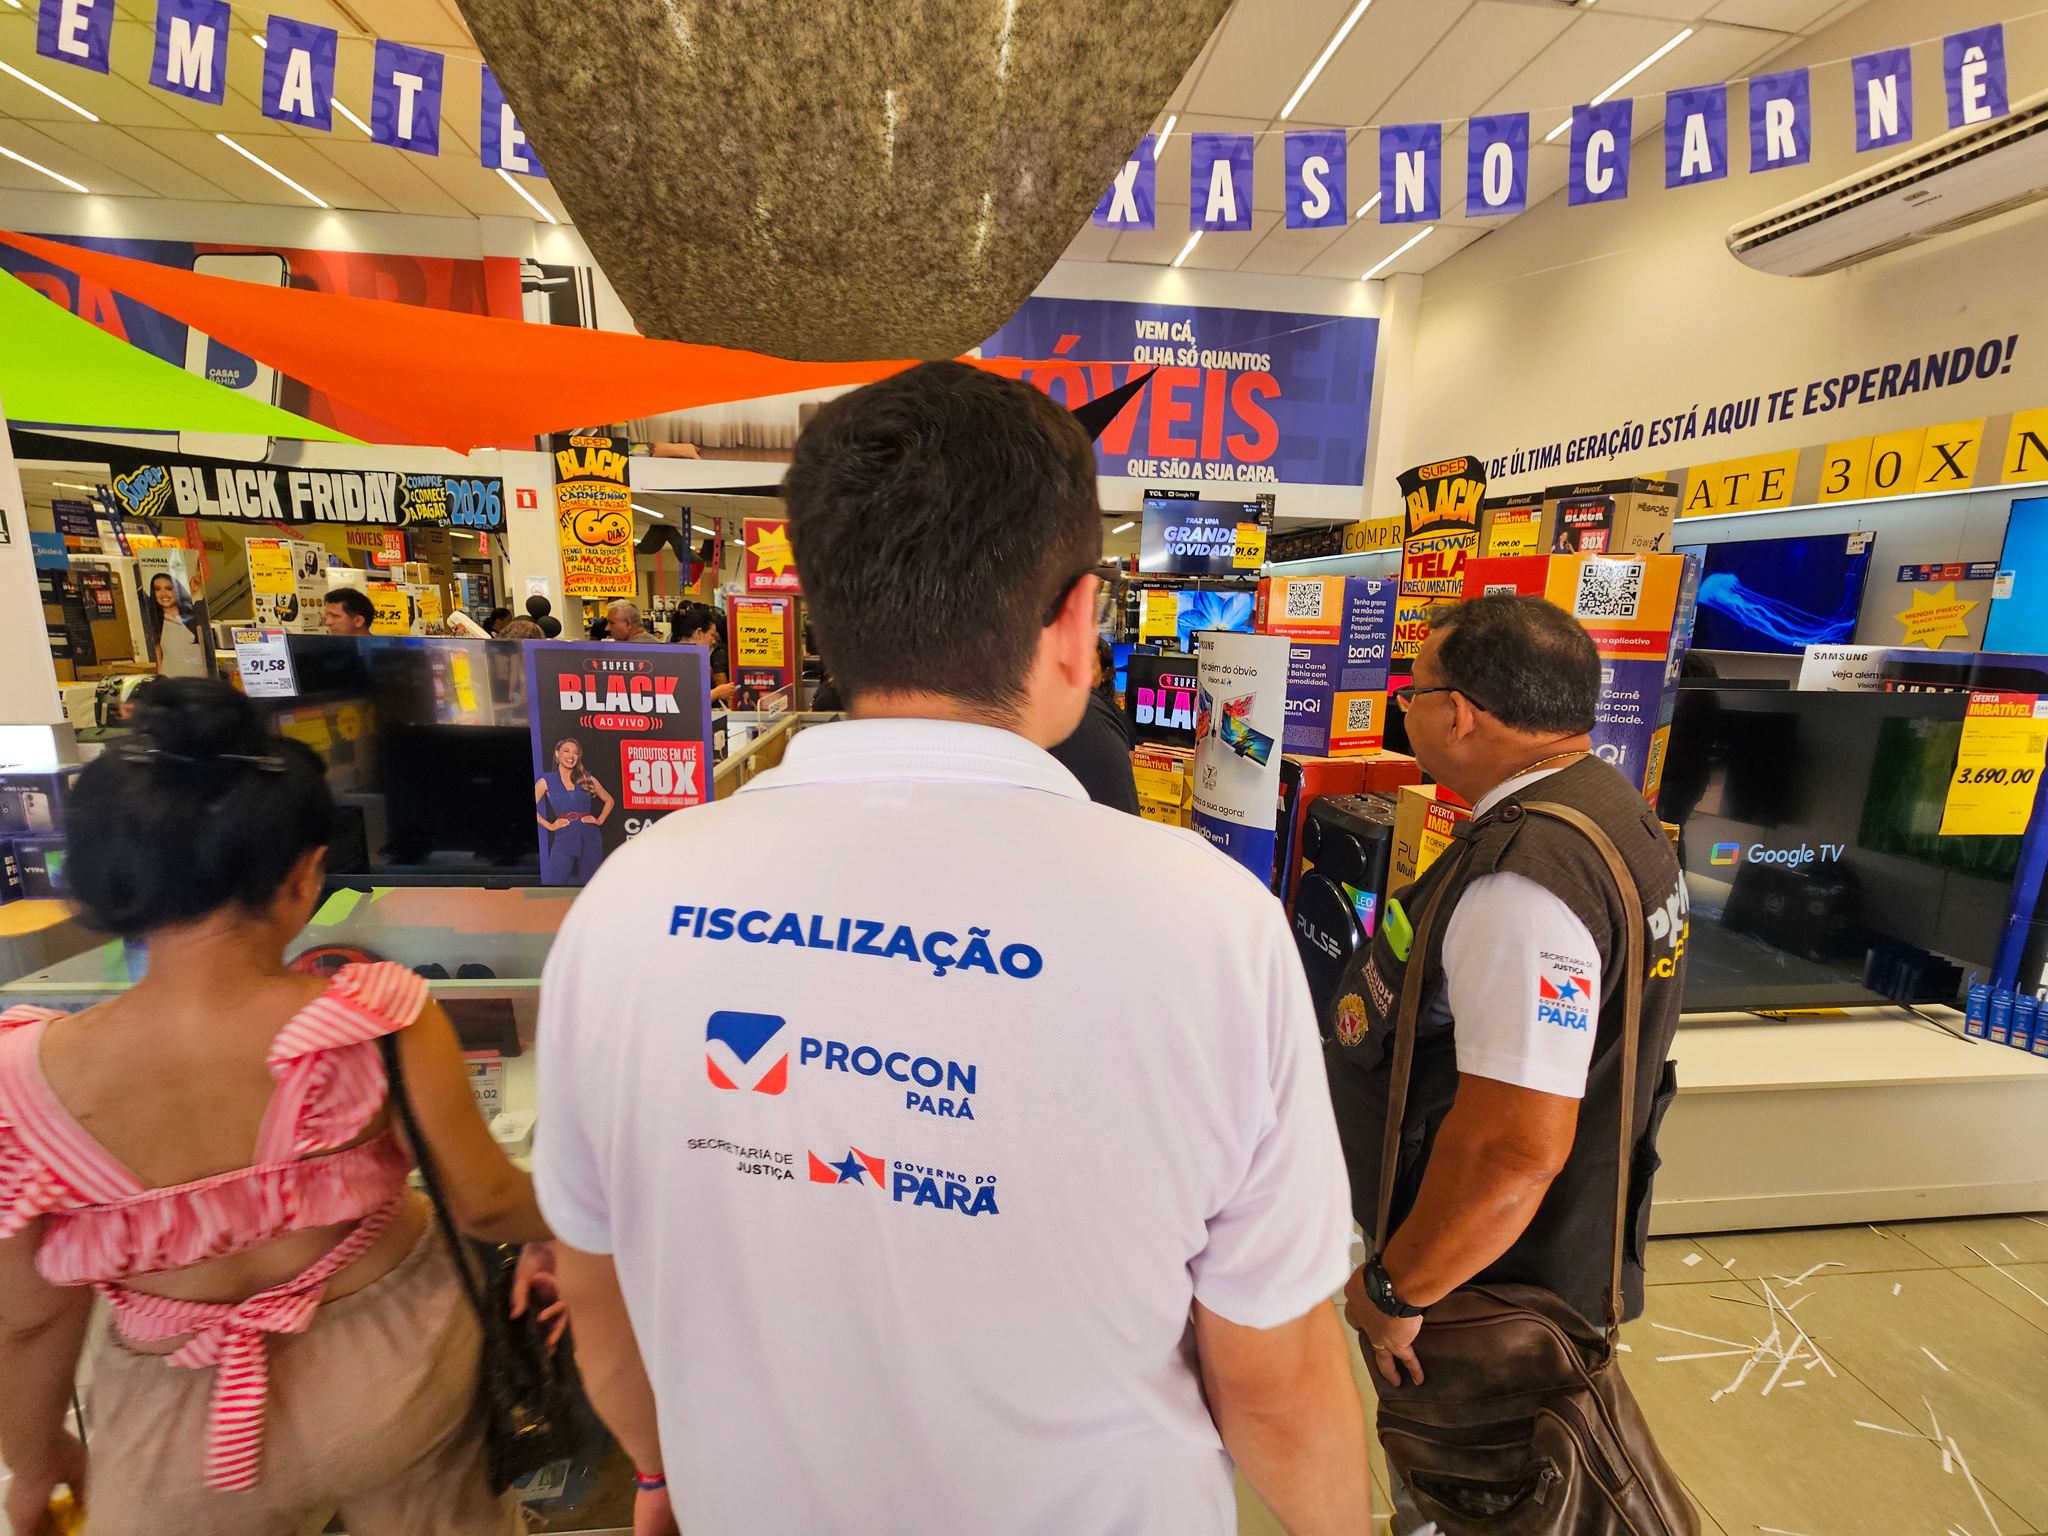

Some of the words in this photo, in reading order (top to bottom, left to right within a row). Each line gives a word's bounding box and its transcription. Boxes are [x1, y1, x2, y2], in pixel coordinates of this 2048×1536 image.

[1135, 320, 1168, 340] VEM
[1171, 319, 1196, 345] CÁ,
[1134, 345, 1174, 366] OLHA
[1178, 345, 1198, 367] SÓ
[1201, 350, 1270, 372] QUANTOS
[209, 368, 239, 378] CASAS
[1000, 334, 1281, 462] ÓVEIS
[1490, 456, 1508, 480] DE
[1510, 445, 1562, 475] ÚLTIMA
[1566, 420, 1644, 464] GERAÇÃO
[1648, 404, 1699, 447] ESTÁ
[1702, 396, 1760, 437] AQUI
[1768, 387, 1798, 423] TE
[1802, 334, 2018, 416] ESPERANDO!
[572, 437, 608, 447] SUPER
[556, 447, 628, 483] BLACK
[1127, 459, 1158, 477] QUE
[1160, 458, 1190, 478] SÃO
[1192, 462, 1202, 479] A
[1205, 463, 1234, 481] SUA
[1237, 465, 1278, 483] CARA.
[1422, 459, 1466, 479] SUPER
[406, 476, 443, 488] COMPRE
[1687, 468, 1785, 510] ATE
[1827, 440, 1972, 495] 30X
[118, 466, 163, 510] Super
[170, 466, 283, 518] BLACK
[288, 472, 397, 523] FRIDAY
[415, 488, 446, 503] COMECE
[560, 485, 606, 493] COMPRE
[1572, 484, 1602, 494] Amvox
[445, 479, 500, 525] 2026
[560, 492, 627, 502] CARNEZINHO
[562, 500, 590, 508] COMECE
[600, 500, 628, 508] PAGAR
[416, 502, 447, 520] PAGAR
[1407, 478, 1486, 533] BLACK
[1494, 515, 1529, 524] IMBATÍVEL
[1565, 507, 1605, 522] BLACK
[438, 518, 451, 527] EM
[573, 509, 631, 546] 60
[346, 528, 383, 547] MÓVEIS
[607, 527, 626, 540] DIAS
[1164, 526, 1237, 543] GRANDE
[1408, 535, 1466, 555] SHOW
[1465, 534, 1477, 548] DE
[1581, 537, 1605, 549] 30X
[37, 547, 62, 555] Midea
[1236, 548, 1259, 557] 91,62
[567, 565, 592, 574] LINHA
[594, 564, 629, 574] BRANCA
[1408, 550, 1467, 579] TELA
[755, 576, 772, 585] SEM
[1351, 615, 1383, 623] Empréstimo
[1400, 606, 1427, 622] NÃO
[1905, 610, 1934, 620] MENOR
[1936, 604, 1965, 615] PREÇO
[1912, 617, 1933, 625] BLACK
[1934, 613, 1958, 622] FRIDAY
[1393, 641, 1419, 654] ANTES
[1609, 637, 1651, 646] aplicativo
[1348, 645, 1384, 659] banQi
[1814, 652, 1868, 661] SAMSUNG
[251, 660, 285, 672] 91,58
[602, 661, 635, 671] SUPER
[1222, 665, 1231, 674] do
[1233, 665, 1257, 676] óbvio
[744, 675, 775, 685] BLACK
[1208, 676, 1219, 684] Vision
[1832, 670, 1852, 680] Veja
[1855, 670, 1879, 679] além
[559, 674, 680, 714] BLACK
[1603, 690, 1640, 700] Carnê
[1972, 695, 1999, 703] OFERTA
[1284, 699, 1321, 713] anQi
[1614, 704, 1640, 712] com
[1969, 702, 2031, 716] IMBATÍVEL
[599, 717, 614, 727] AO
[618, 718, 644, 728] VIVO
[628, 746, 668, 760] PRODUTOS
[669, 748, 680, 760] EM
[682, 745, 696, 761] ATÉ
[1135, 753, 1150, 761] OFERTA
[1134, 759, 1170, 771] IMBATÍVEL
[629, 760, 698, 795] 30X
[1957, 768, 2035, 786] 3.690,00
[1219, 807, 1244, 818] agora!
[1430, 805, 1454, 821] OFERTA
[1212, 835, 1223, 844] em
[1426, 836, 1446, 850] TORRE
[1748, 843, 1815, 868] Google
[1820, 844, 1845, 863] TV
[1356, 894, 1373, 907] LED
[668, 904, 1043, 979] FISCALIZAÇÃO
[1297, 913, 1341, 959] PULSE
[1539, 951, 1586, 967] SECRETARIA
[1553, 963, 1584, 975] JUSTIÇA
[1539, 998, 1577, 1011] GOVERNO
[800, 1037, 976, 1094] PROCON
[906, 1091, 975, 1120] PARÁ
[687, 1138, 772, 1160] SECRETARIA
[774, 1152, 793, 1165] DE
[736, 1162, 794, 1180] JUSTIÇA
[893, 1161, 966, 1183] GOVERNO
[975, 1175, 997, 1185] DO
